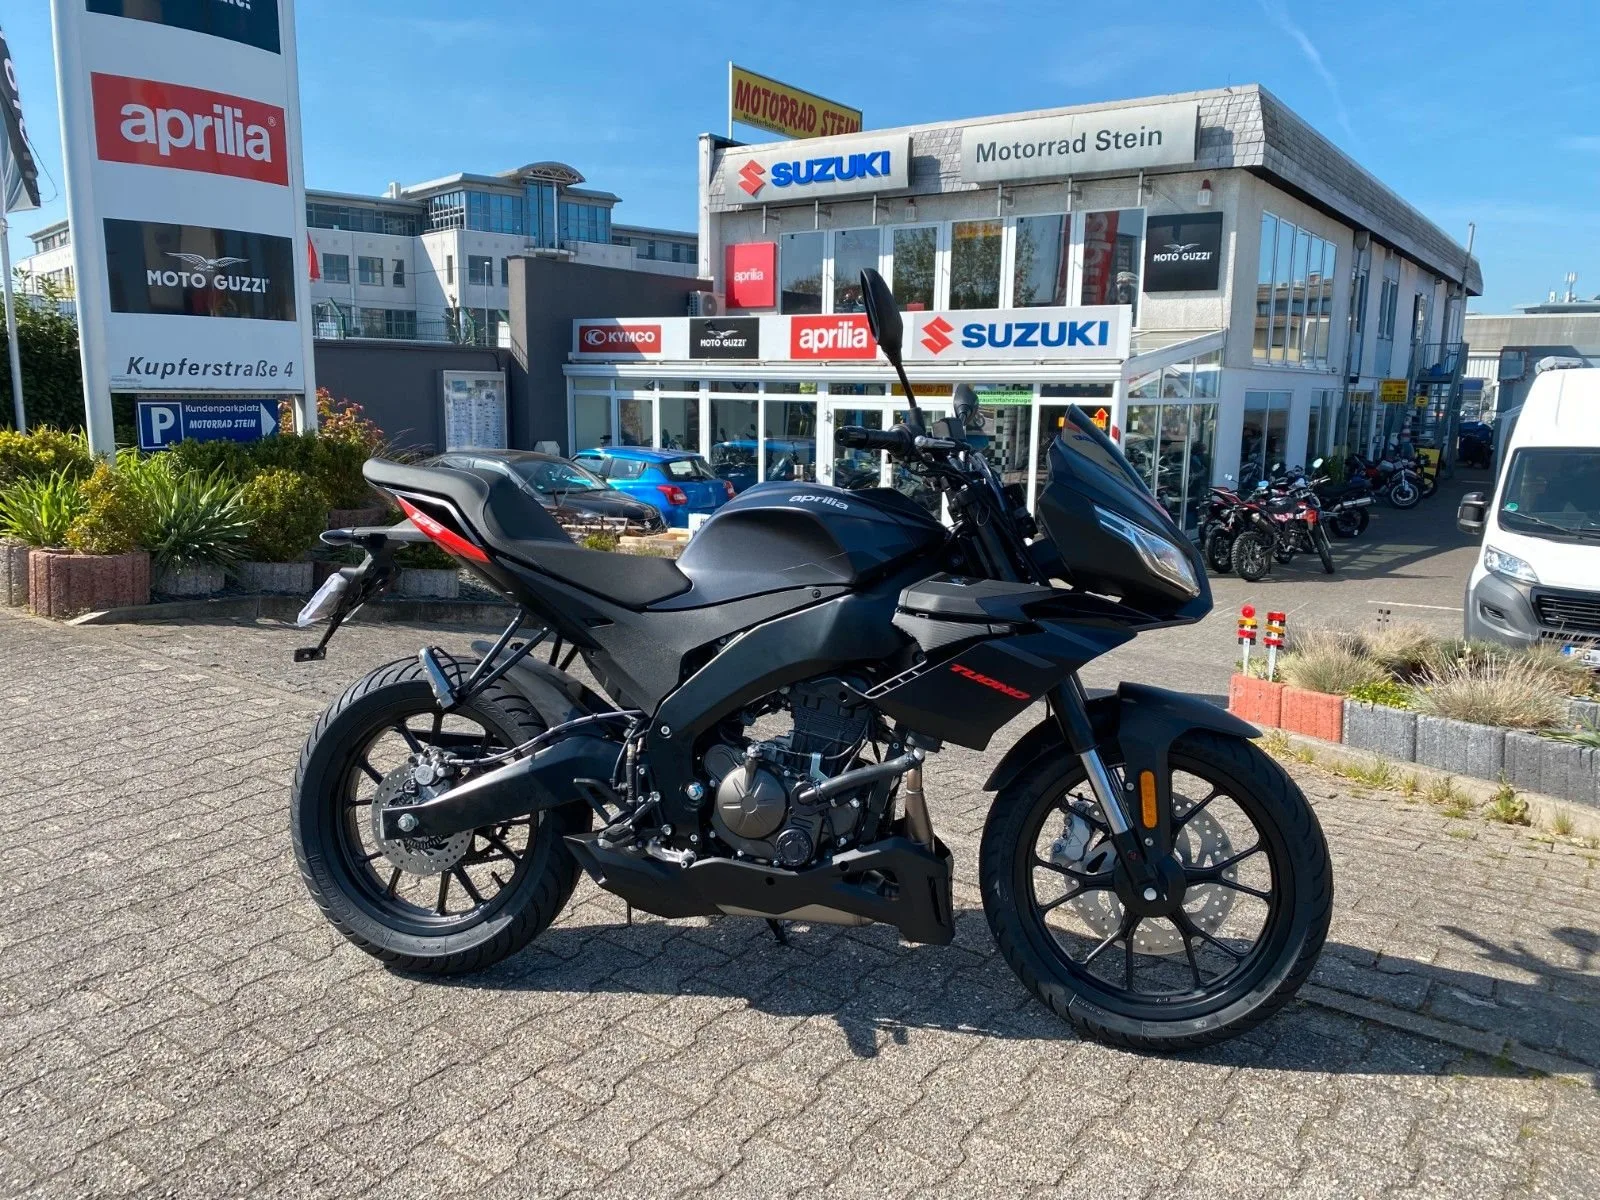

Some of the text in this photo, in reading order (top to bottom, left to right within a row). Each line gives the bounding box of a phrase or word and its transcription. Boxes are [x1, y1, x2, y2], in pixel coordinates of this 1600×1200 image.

[735, 79, 817, 133] MOTORRAD
[120, 103, 272, 163] aprilia
[976, 126, 1163, 163] Motorrad Stein
[771, 150, 890, 188] SUZUKI
[1153, 251, 1211, 262] MOTO GUZZI
[147, 270, 267, 294] MOTO GUZZI
[734, 267, 764, 283] aprilia
[608, 331, 656, 343] KYMCO
[700, 338, 745, 348] MOTO GUZZI
[799, 320, 868, 353] aprilia
[961, 320, 1110, 348] SUZUKI
[126, 356, 278, 380] Kupferstraße
[283, 361, 294, 378] 4
[185, 404, 260, 414] Kundenparkplatz
[151, 406, 175, 444] P
[189, 418, 256, 429] MOTORRAD STEIN
[788, 494, 849, 511] aprilia
